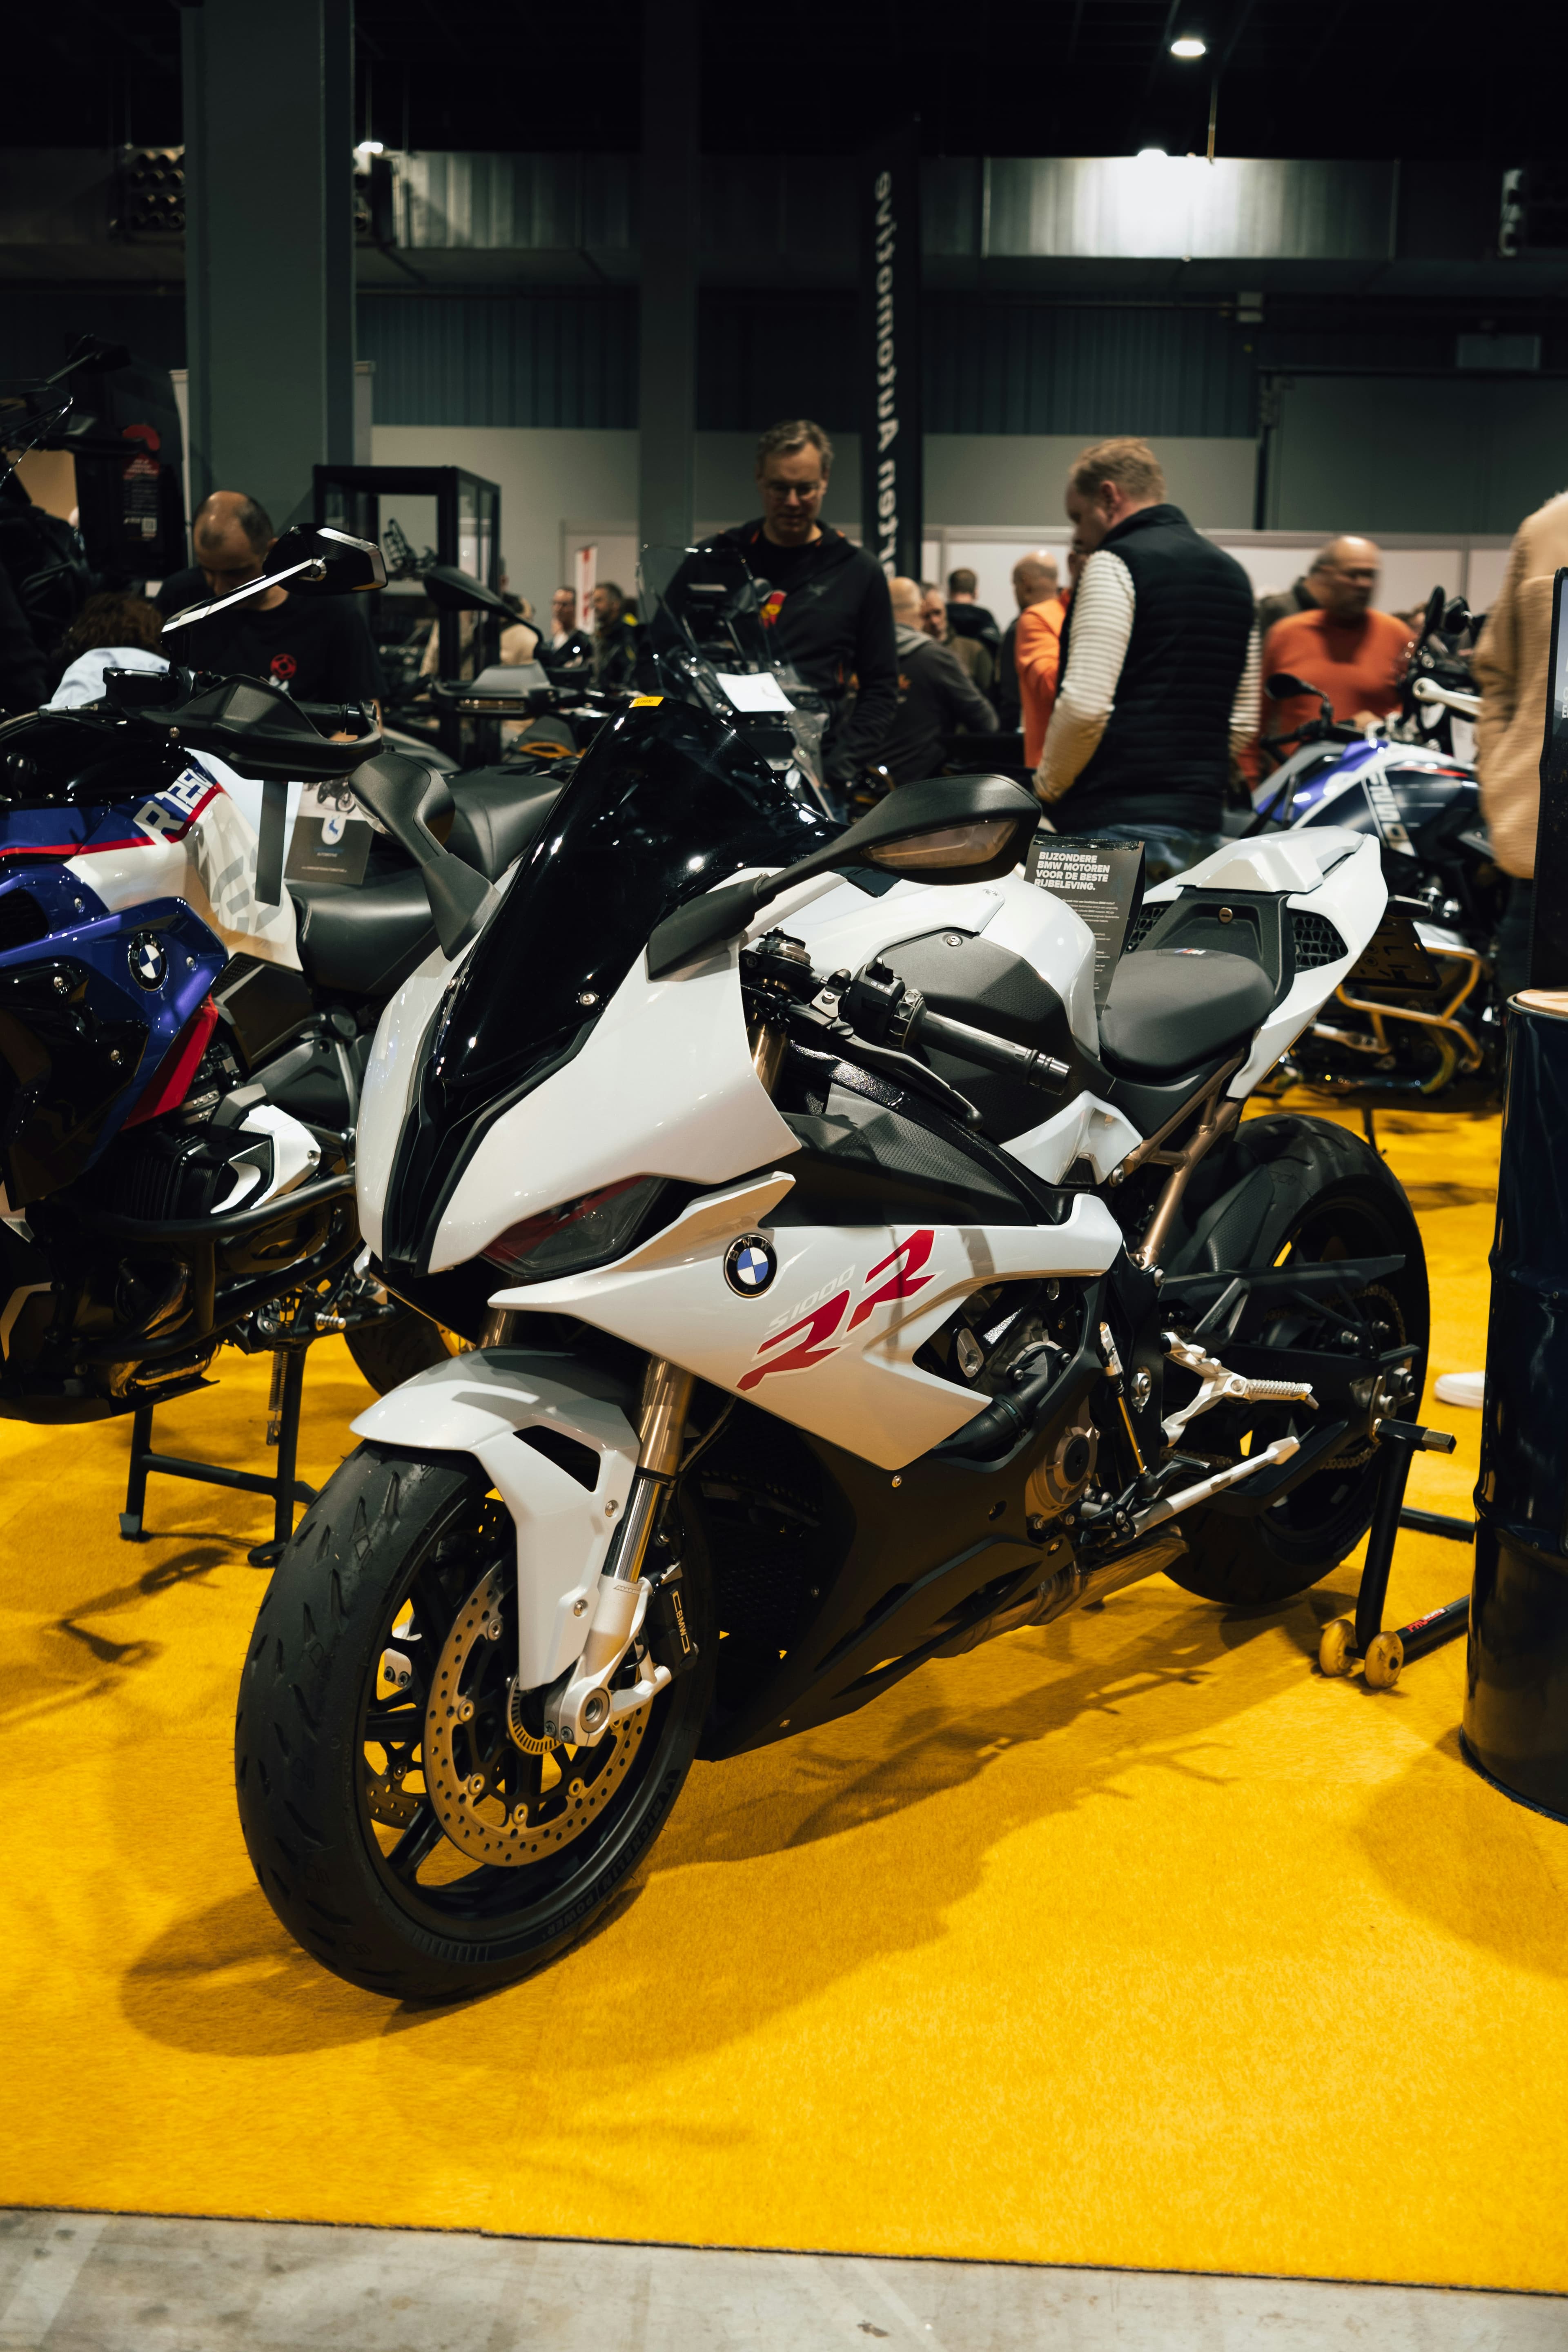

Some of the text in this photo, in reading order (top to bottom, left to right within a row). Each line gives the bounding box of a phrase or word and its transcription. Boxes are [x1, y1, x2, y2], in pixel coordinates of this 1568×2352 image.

[1037, 860, 1110, 873] BMW MOTOREN
[1039, 851, 1098, 863] BIJZONDERE
[1034, 878, 1096, 891] RIJBELEVING.
[1036, 869, 1109, 882] VOOR DE BESTE
[131, 933, 159, 960] BMW
[729, 1237, 770, 1261] BMW
[768, 1265, 856, 1328] S1000
[676, 1609, 687, 1636] BMW
[548, 1798, 665, 1935] MICHELIN POWER
